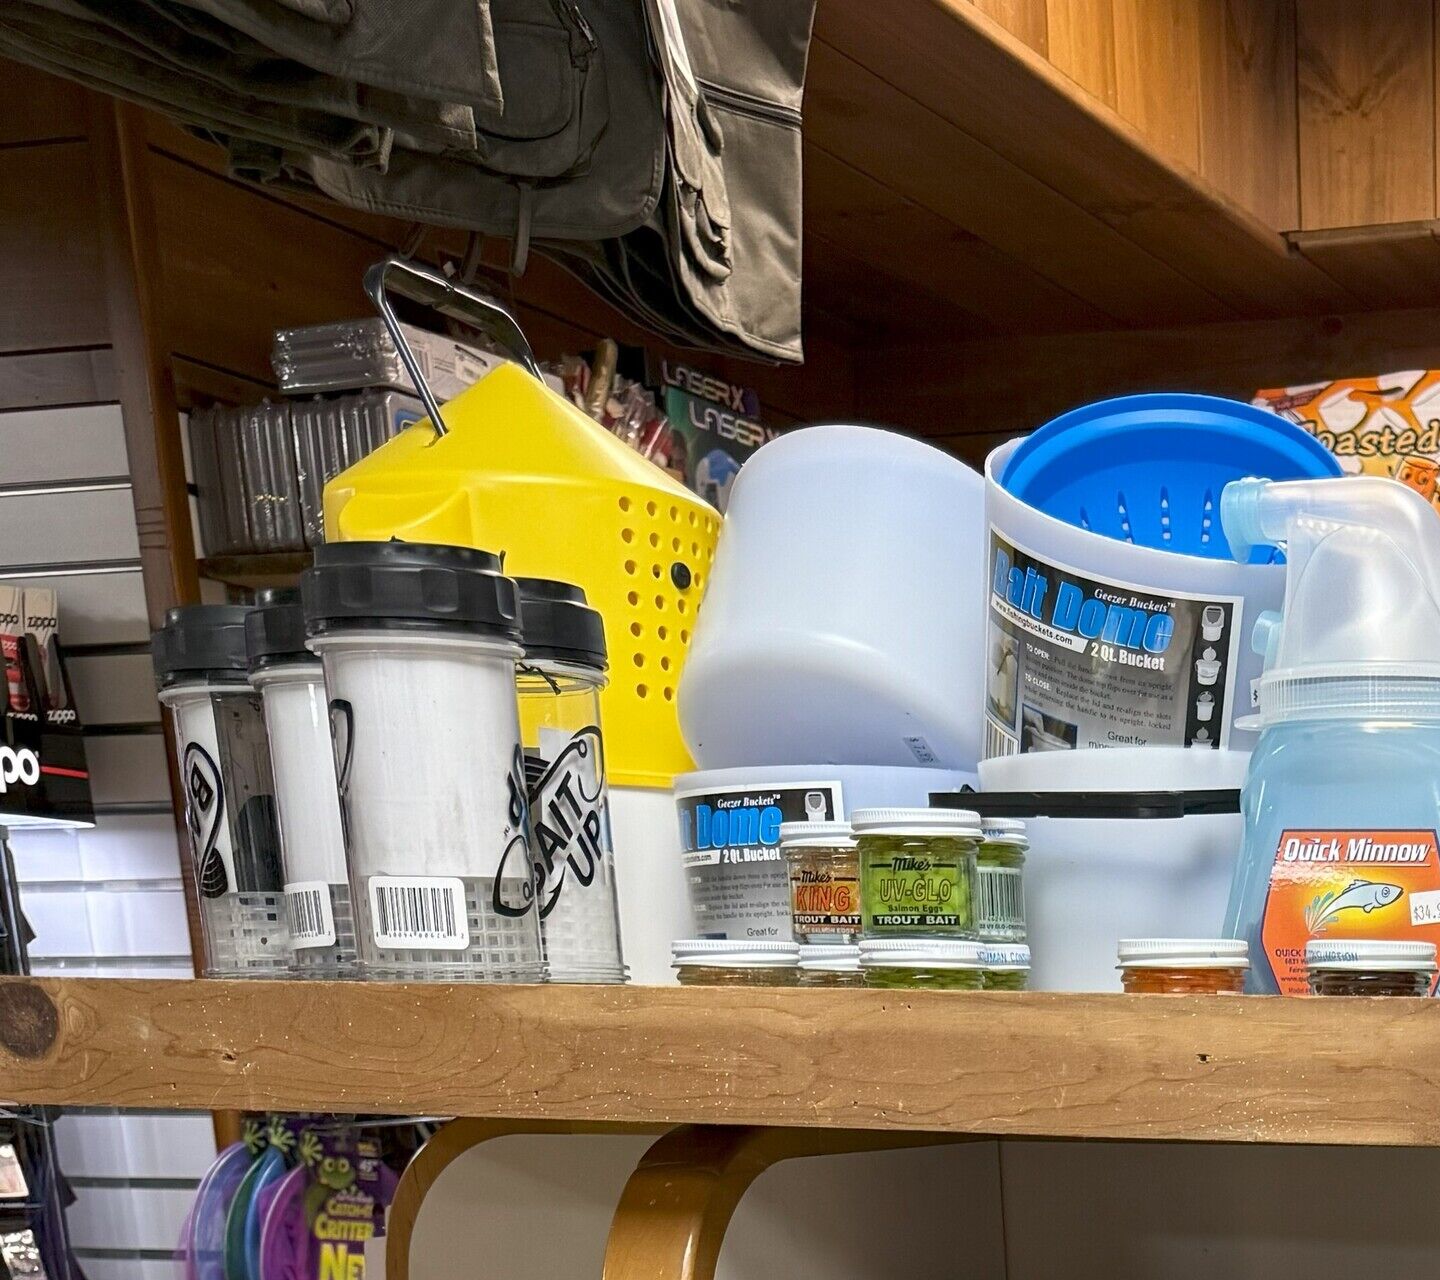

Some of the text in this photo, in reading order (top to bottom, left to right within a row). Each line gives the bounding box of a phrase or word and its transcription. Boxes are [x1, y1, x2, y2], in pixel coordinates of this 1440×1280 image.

[993, 547, 1175, 654] Bait Dome
[1094, 588, 1127, 605] Geezer
[1090, 642, 1099, 658] 2
[1119, 650, 1165, 671] Bucket
[1283, 838, 1431, 863] Quick Minnow
[892, 857, 932, 871] Mike's
[802, 870, 832, 883] Mike's
[796, 886, 850, 911] KING
[880, 878, 952, 902] UV-GLO
[888, 904, 943, 914] Salmon Eggs
[795, 916, 826, 924] TROUT
[877, 915, 957, 924] TROUT BAIT
